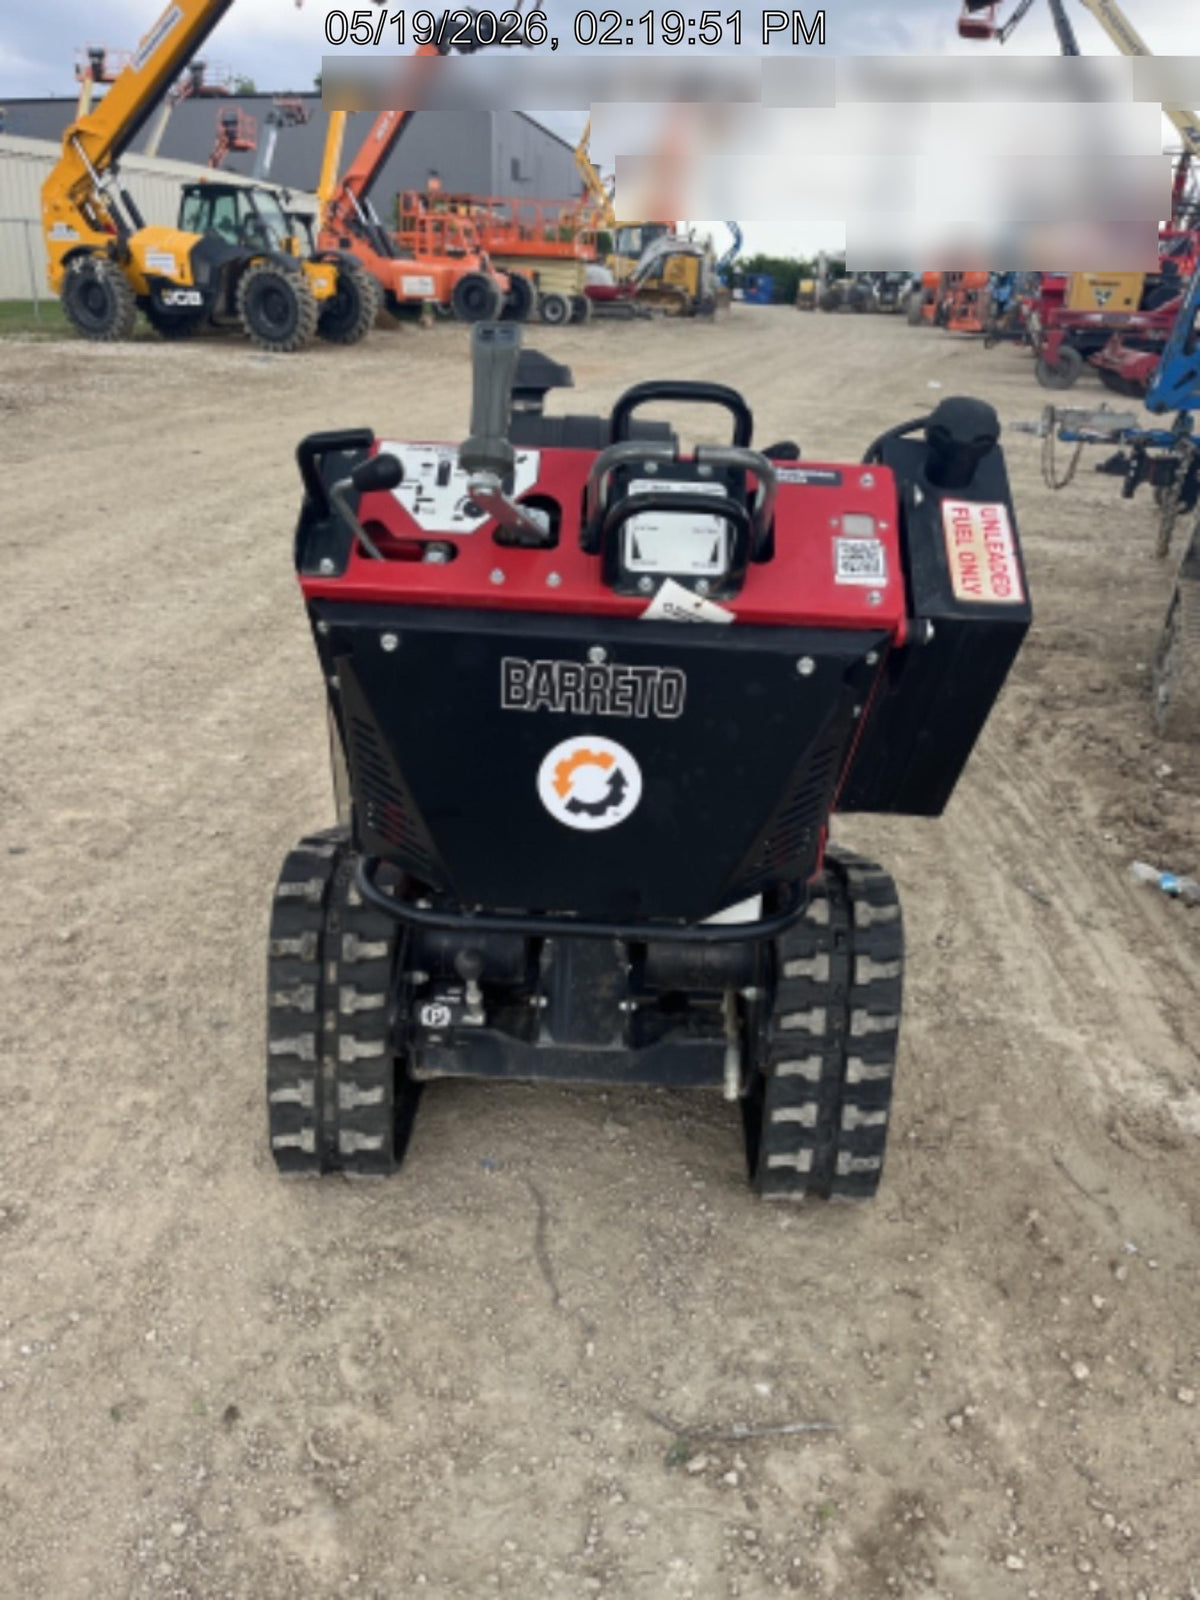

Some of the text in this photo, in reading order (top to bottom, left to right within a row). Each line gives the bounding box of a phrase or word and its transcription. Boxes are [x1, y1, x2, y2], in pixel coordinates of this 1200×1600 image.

[952, 507, 982, 595] FUEL ONLY
[980, 507, 1012, 597] UNLEADED
[501, 657, 686, 718] BARRETO
